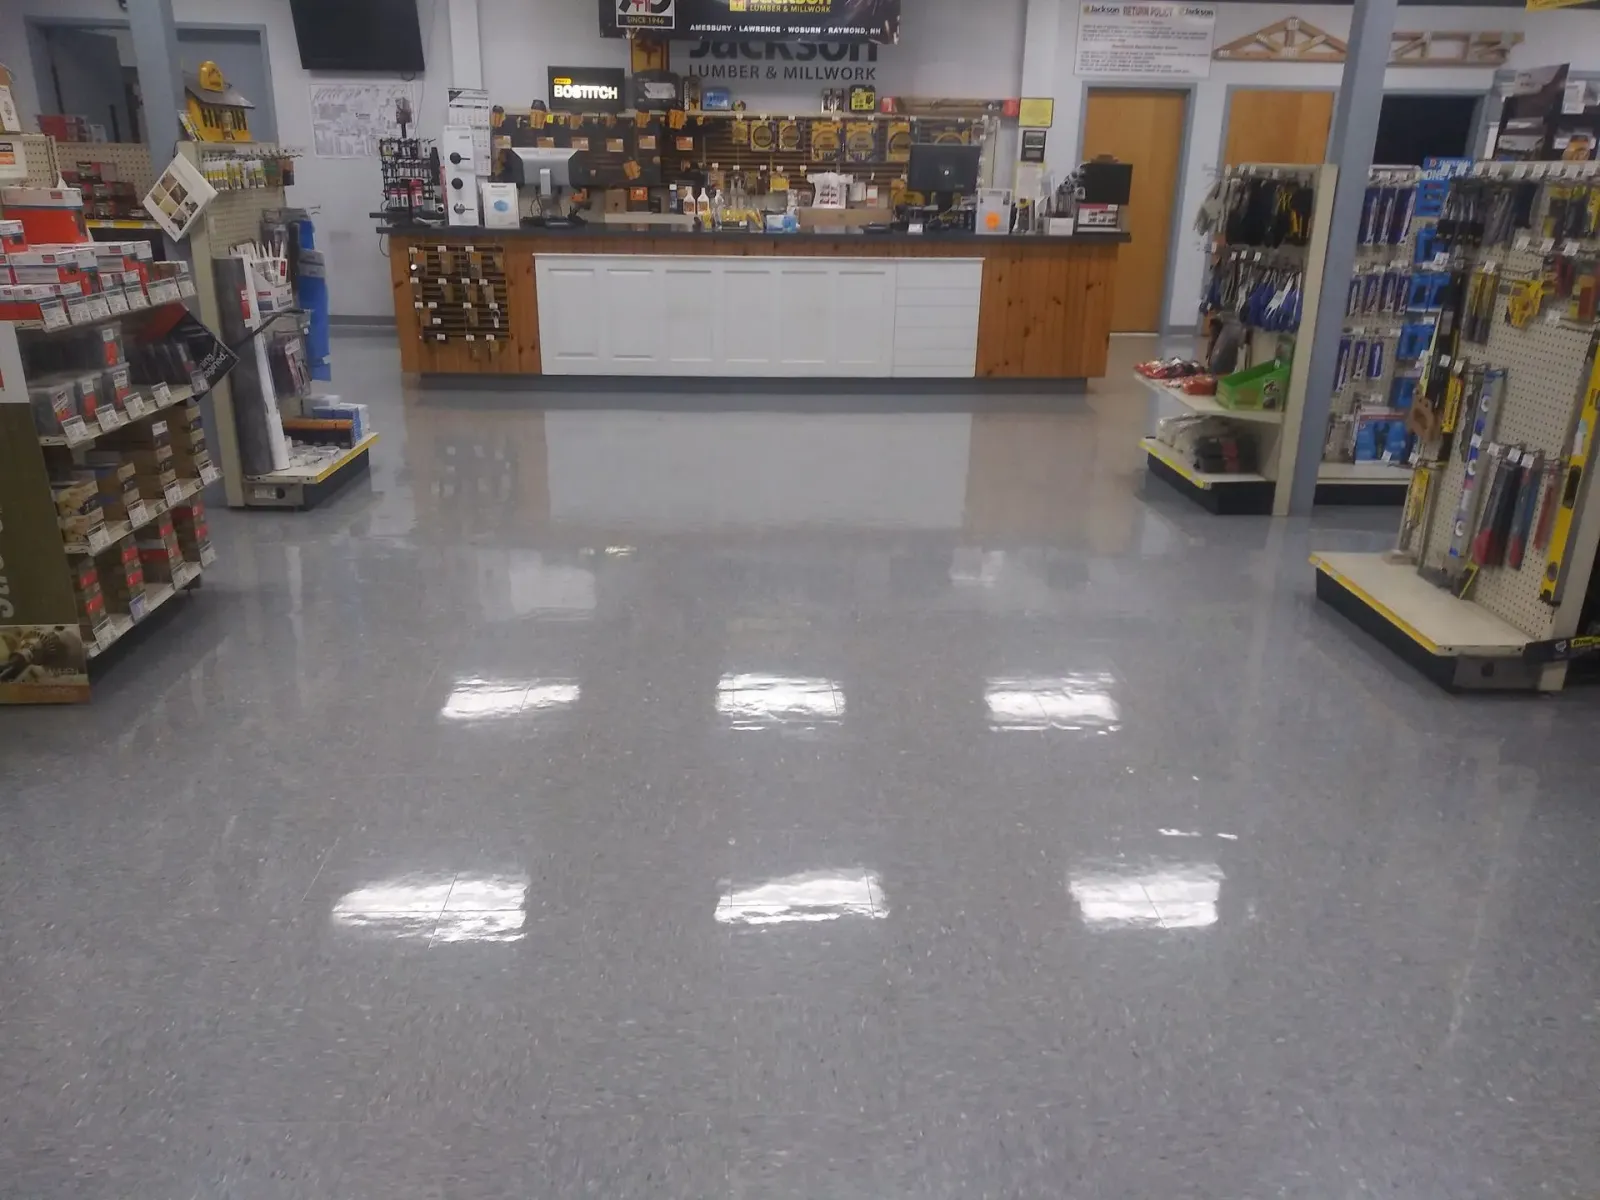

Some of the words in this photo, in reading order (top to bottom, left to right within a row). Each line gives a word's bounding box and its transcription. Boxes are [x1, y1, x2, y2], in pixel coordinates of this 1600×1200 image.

[627, 16, 646, 24] SINCE
[689, 24, 732, 32] AMESBURY
[739, 25, 781, 33] LAWRENCE
[788, 26, 821, 34] WOBURN
[689, 64, 760, 79] LUMBER
[766, 66, 777, 80] &
[783, 66, 876, 81] MILLWORK
[553, 85, 618, 99] BOSTITCH
